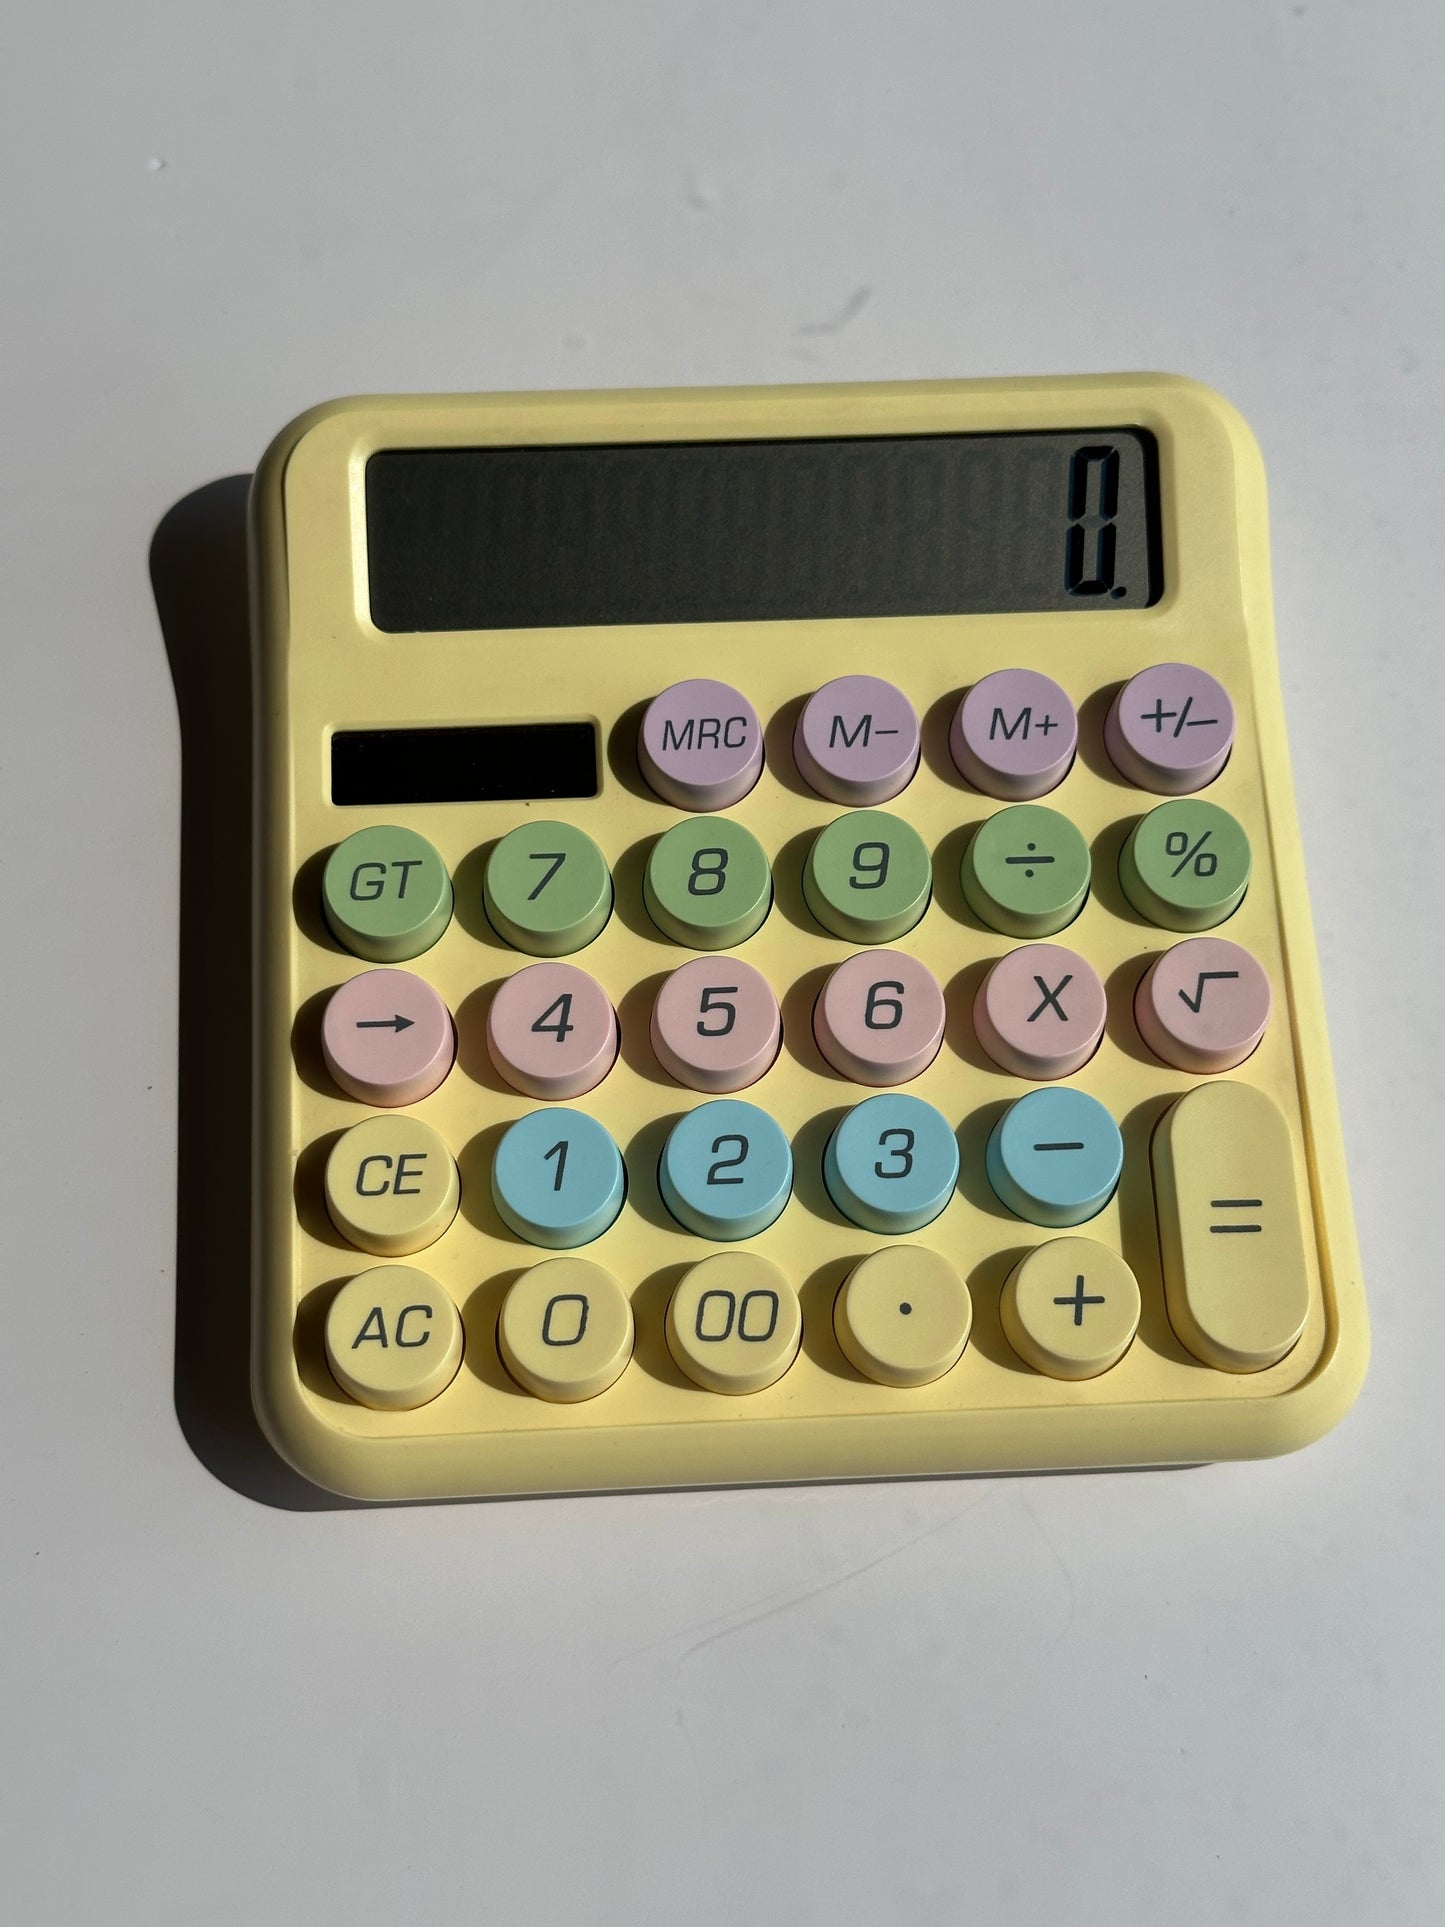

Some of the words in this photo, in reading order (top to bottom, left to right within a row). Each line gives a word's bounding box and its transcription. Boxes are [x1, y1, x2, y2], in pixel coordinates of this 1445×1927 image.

[1064, 445, 1127, 600] 0.
[663, 715, 748, 752] MRC
[830, 715, 898, 748] M-
[990, 708, 1058, 740] M+
[1141, 697, 1218, 737] +/-
[528, 853, 566, 900] 7
[688, 848, 728, 895] 8
[850, 842, 889, 889] 9
[1166, 831, 1217, 877] %
[350, 861, 422, 900] GT
[531, 994, 573, 1042] 4
[697, 987, 738, 1036] 5
[865, 981, 904, 1029] 6
[356, 1154, 427, 1196] CE
[544, 1141, 568, 1191] 1
[707, 1135, 748, 1185] 2
[875, 1129, 914, 1178] 3
[1210, 1200, 1262, 1233] =
[542, 1294, 589, 1346] 0
[696, 1290, 778, 1342] 00
[1054, 1275, 1105, 1326] +
[352, 1305, 432, 1349] AC
